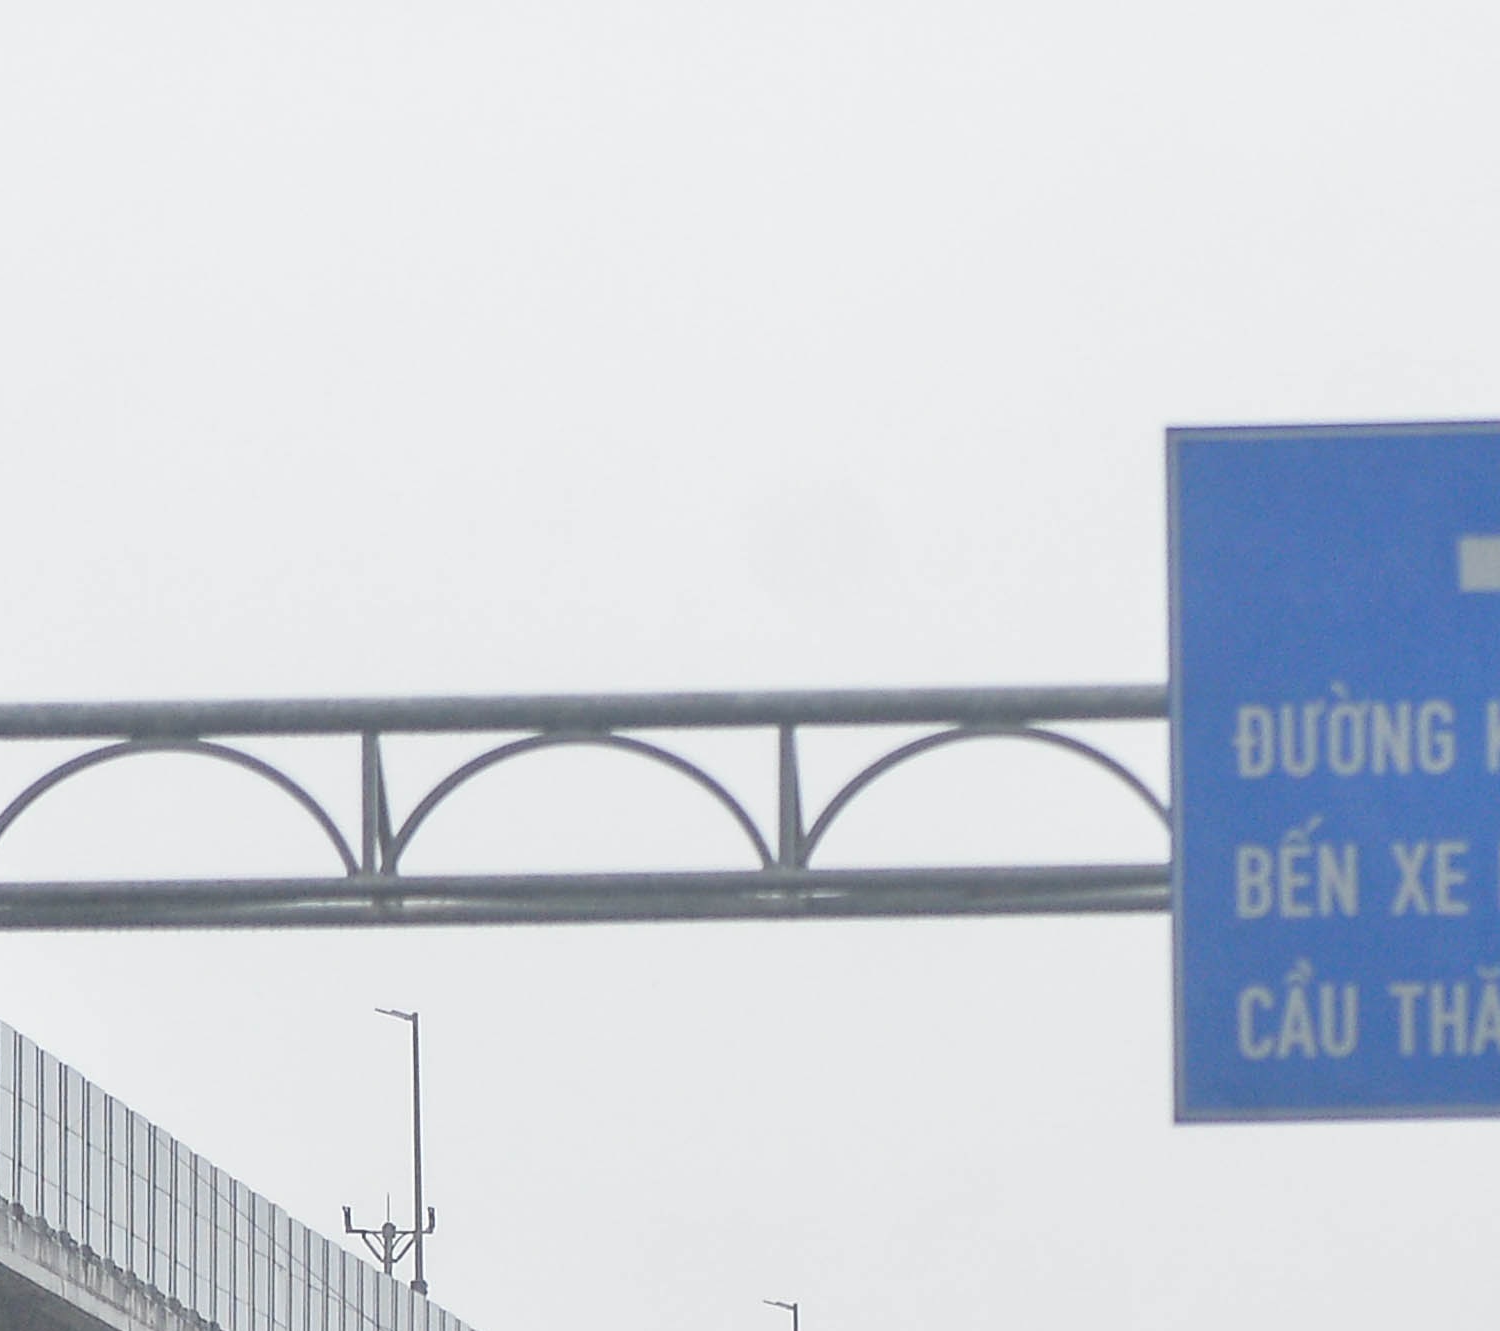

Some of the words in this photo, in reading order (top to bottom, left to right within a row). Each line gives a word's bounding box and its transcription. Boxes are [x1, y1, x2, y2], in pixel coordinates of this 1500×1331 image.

[1234, 683, 1455, 777] ĐƯỜNG
[1237, 817, 1358, 918] BẾN
[1394, 841, 1467, 915] XE
[1238, 960, 1358, 1059] CẦU
